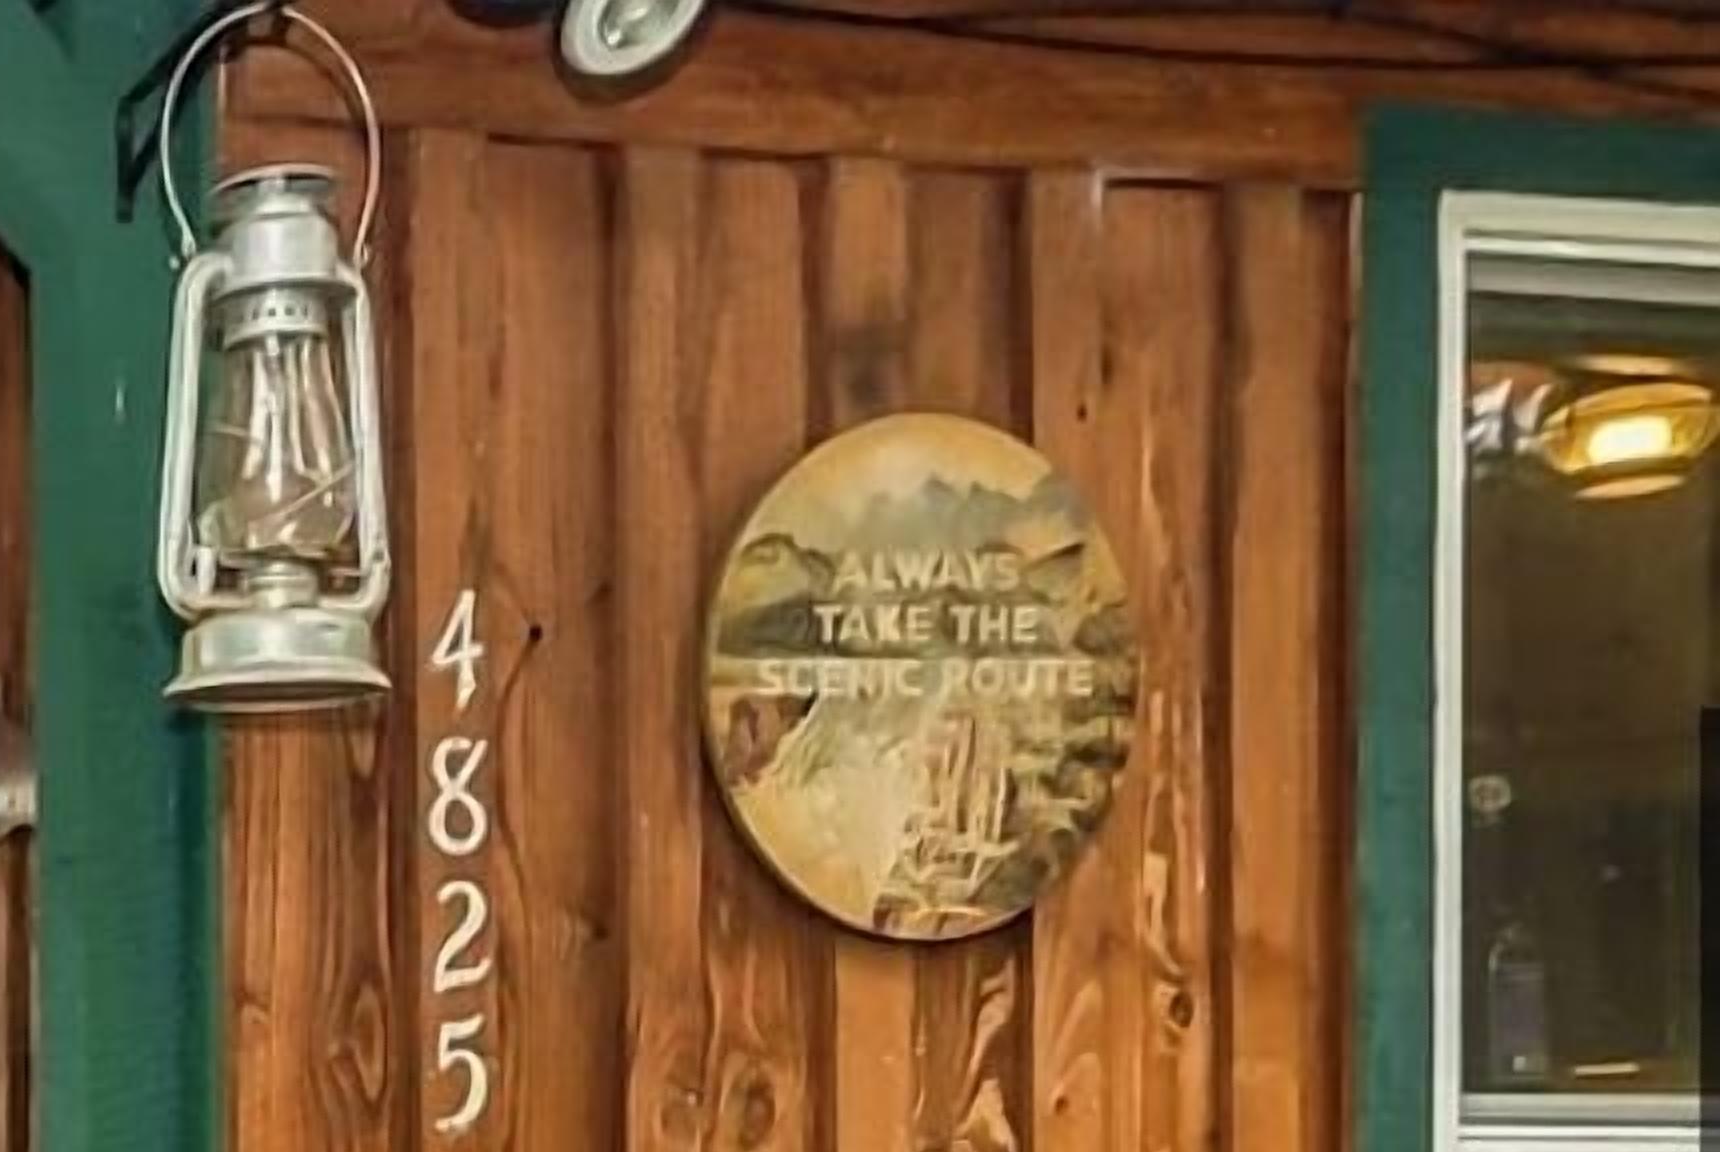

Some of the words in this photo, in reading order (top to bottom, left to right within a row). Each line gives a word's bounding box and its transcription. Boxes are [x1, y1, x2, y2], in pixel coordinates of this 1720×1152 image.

[835, 551, 1020, 591] ALWAYS
[817, 605, 935, 643] TAKE
[953, 605, 1039, 643] THE
[756, 660, 925, 697] SCENIC
[941, 660, 1094, 697] ROUTE
[428, 589, 492, 1134] 4825
